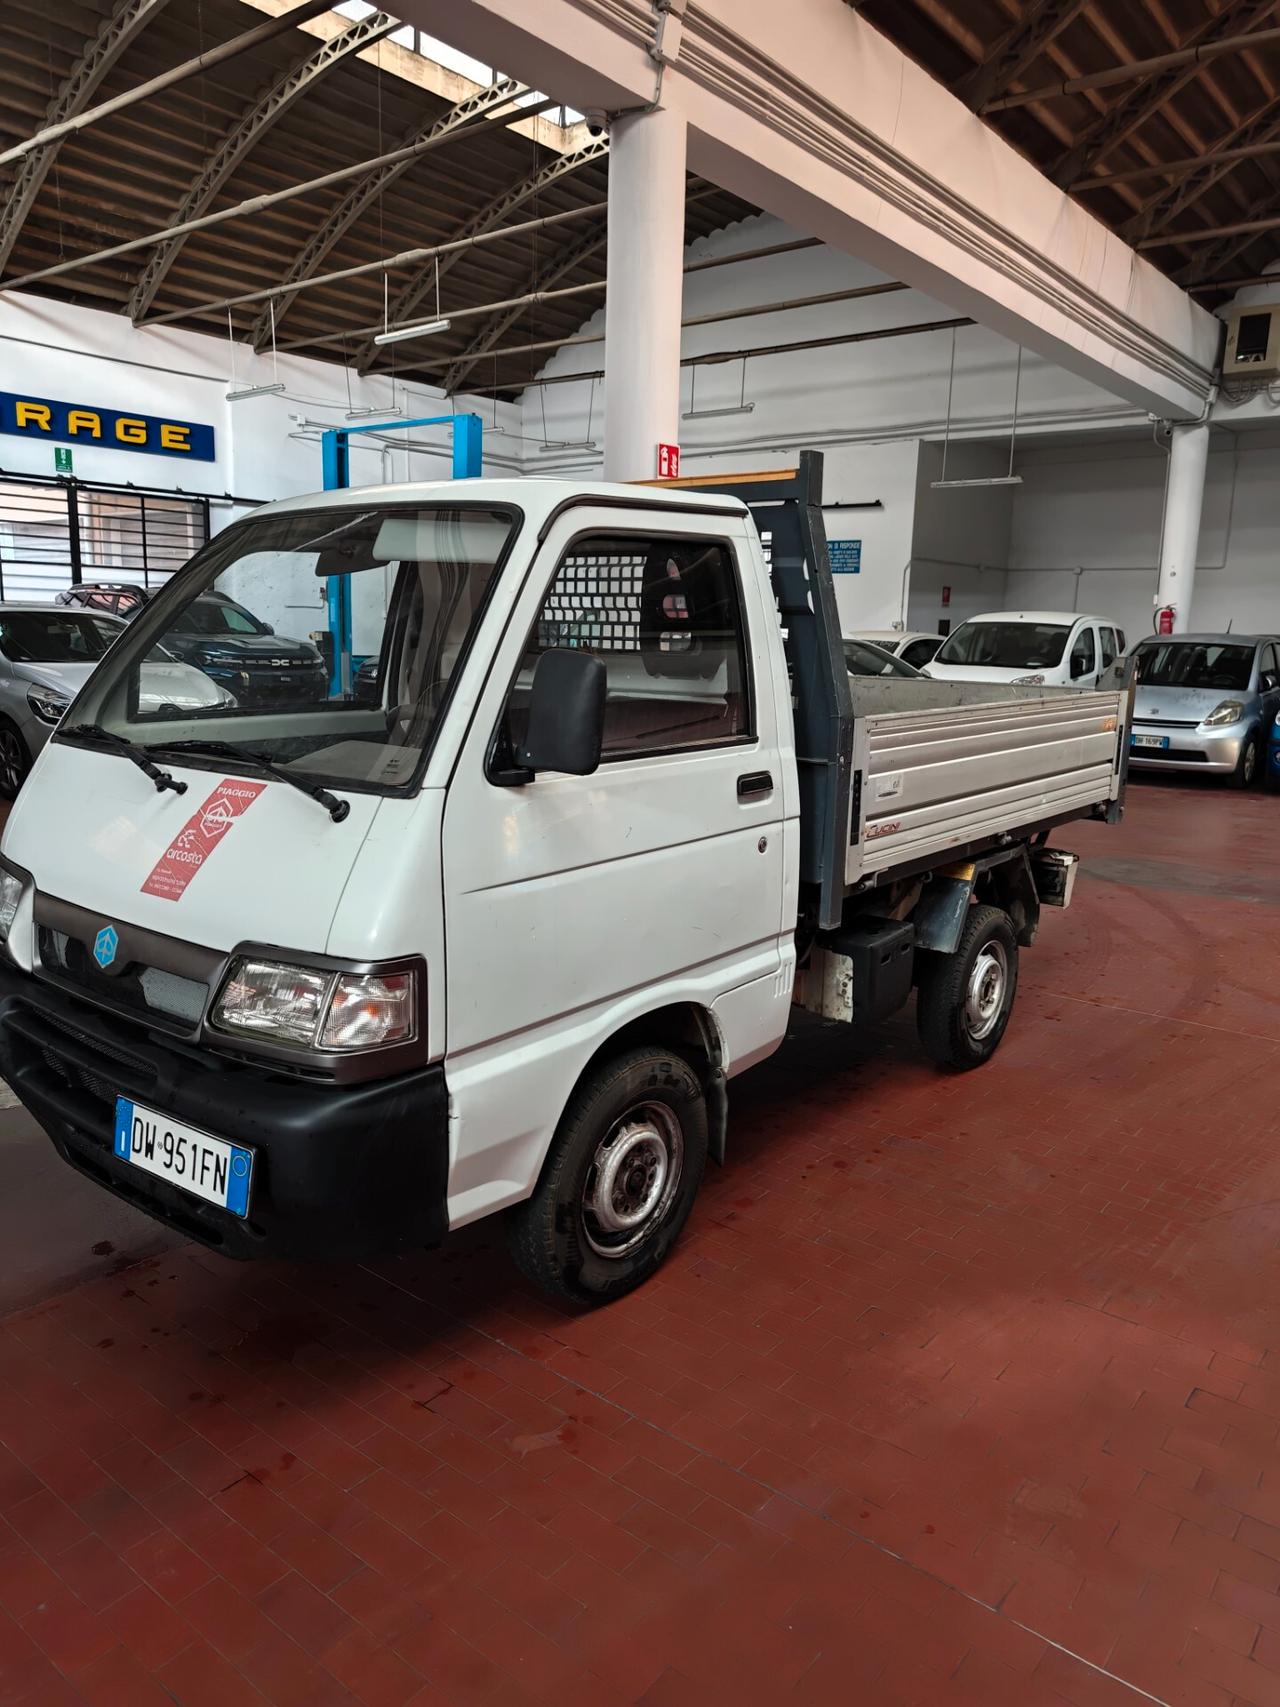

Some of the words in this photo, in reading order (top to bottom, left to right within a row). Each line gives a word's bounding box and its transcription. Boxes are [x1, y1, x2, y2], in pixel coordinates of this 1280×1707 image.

[217, 786, 257, 798] PIAGGIO
[131, 1116, 157, 1161] DW
[162, 1131, 228, 1195] 951FN
